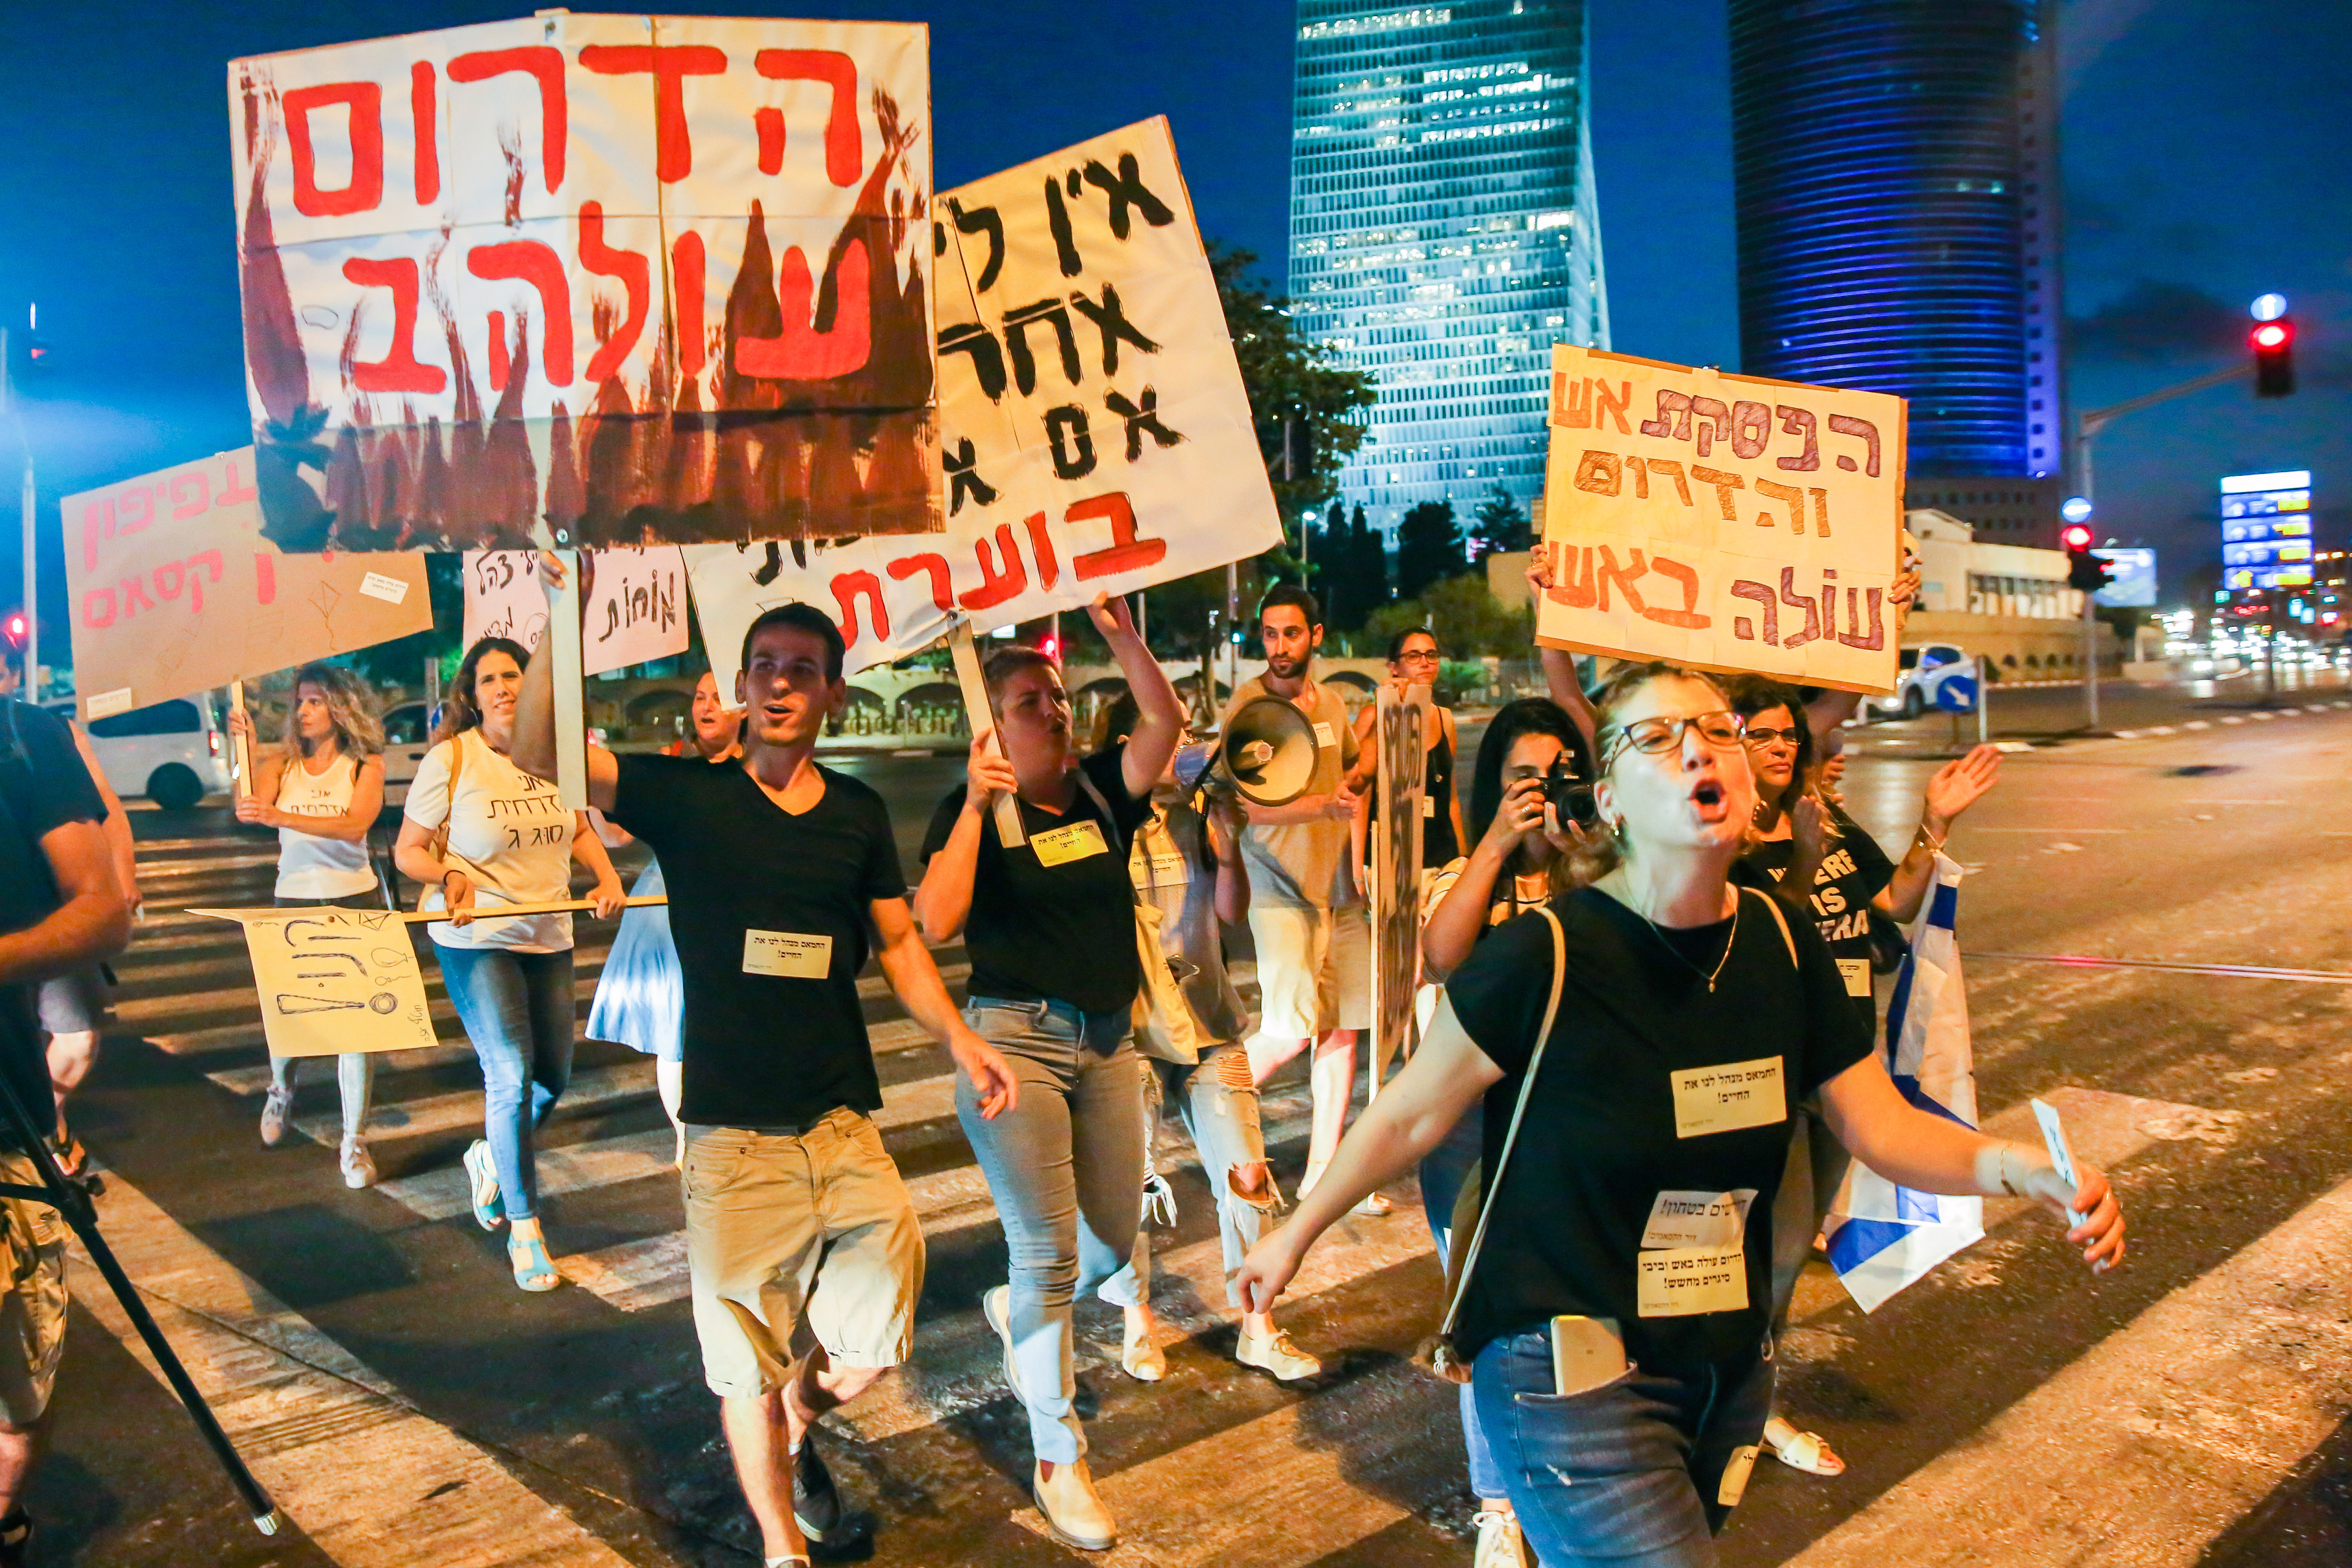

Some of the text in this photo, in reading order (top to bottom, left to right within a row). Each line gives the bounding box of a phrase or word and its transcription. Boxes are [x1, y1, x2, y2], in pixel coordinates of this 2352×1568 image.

[283, 44, 863, 216] הדרום
[1044, 151, 1176, 277] אין
[937, 282, 1162, 405] אחר
[1040, 385, 1187, 481] אם
[1553, 371, 1880, 478] הפסקת אש
[1573, 450, 1831, 537] והדרום
[831, 492, 1166, 650] בוערת
[1547, 540, 1711, 630] באש
[518, 776, 545, 791] אני
[531, 825, 563, 846] סוג
[1809, 887, 1846, 916] IS
[1684, 1068, 1776, 1090] החמאס מנהל לנו את
[1718, 1090, 1750, 1105] החיים!
[1671, 1259, 1694, 1269] באש
[1697, 1255, 1717, 1268] עולה
